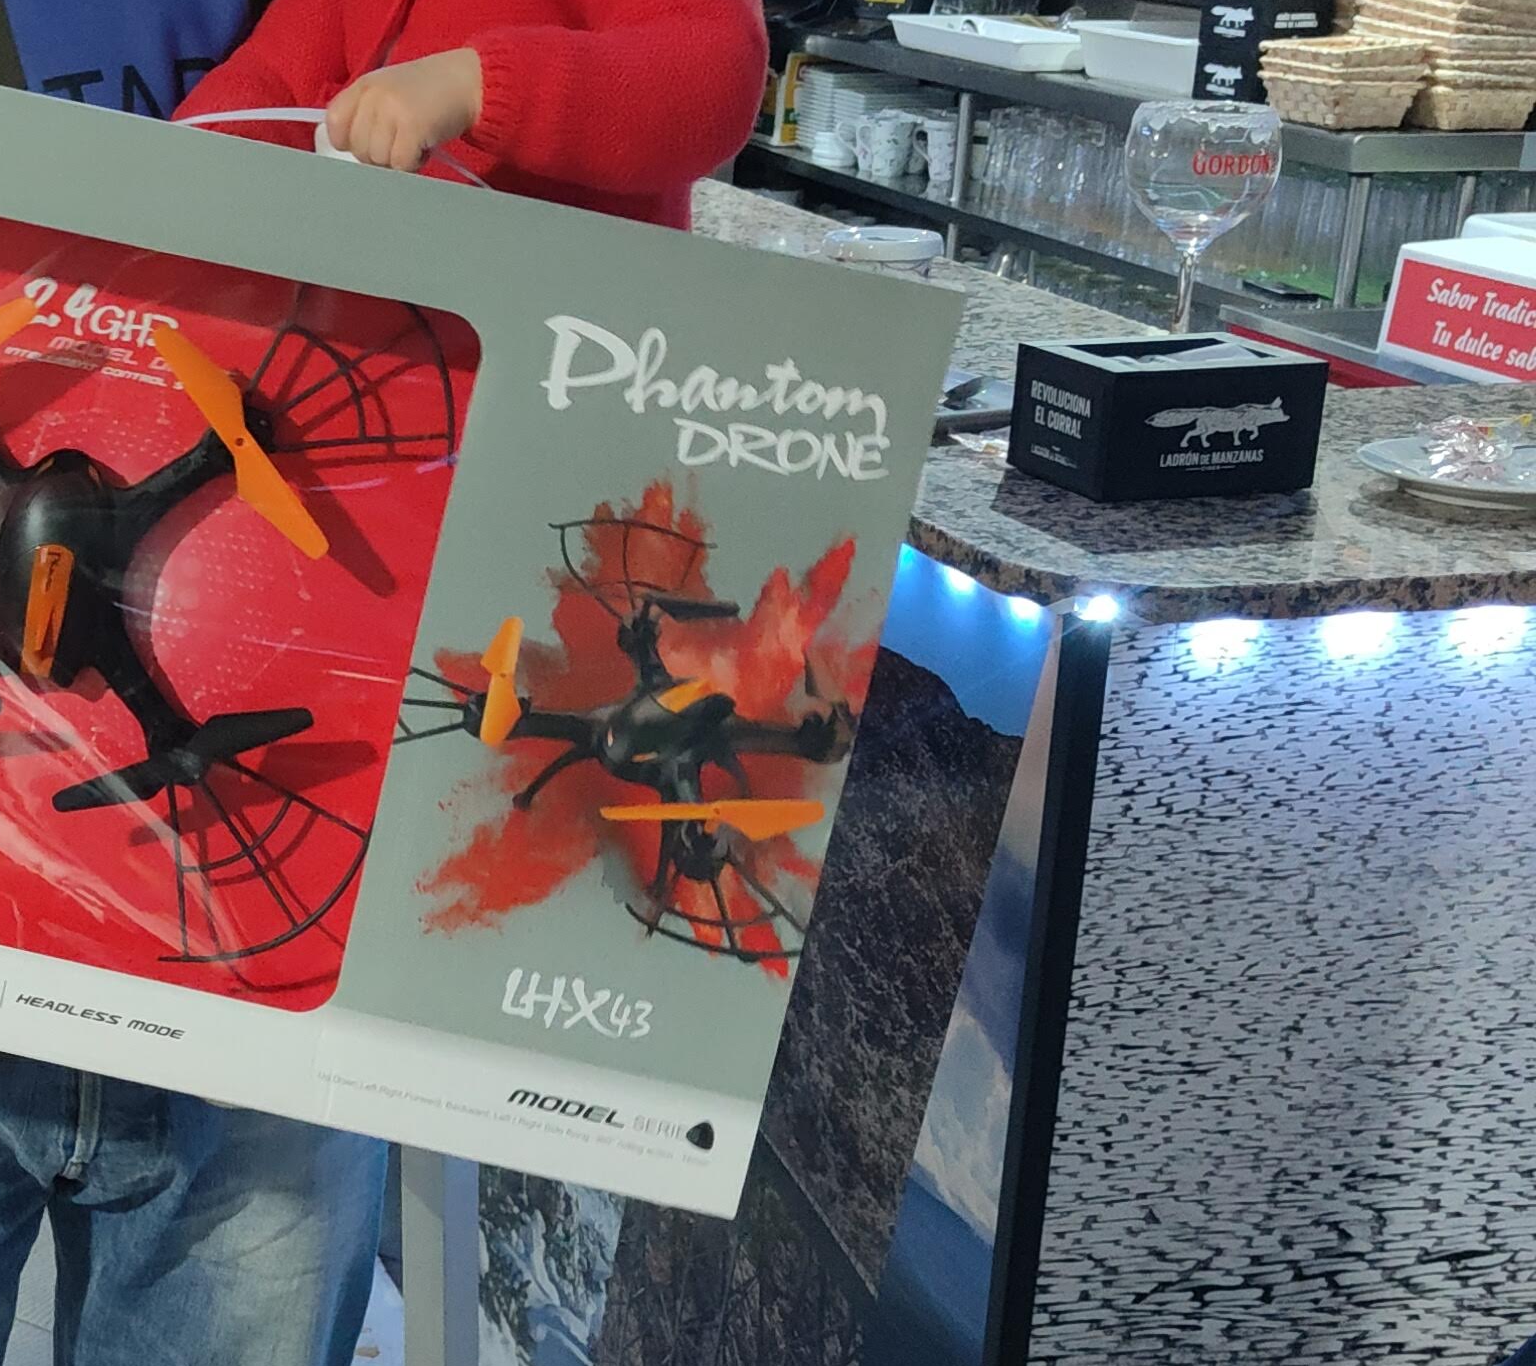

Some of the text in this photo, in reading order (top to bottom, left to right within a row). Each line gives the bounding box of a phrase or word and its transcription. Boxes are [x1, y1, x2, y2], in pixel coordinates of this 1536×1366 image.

[1426, 278, 1479, 312] Sabor
[1432, 320, 1453, 347] Tu
[1454, 327, 1504, 361] dulce
[100, 366, 168, 388] CONTROL
[539, 315, 889, 438] Phantom
[1030, 379, 1091, 419] REVOLUCIONA
[1034, 404, 1082, 440] EL CORRAL
[672, 417, 891, 481] DRONE
[1159, 450, 1200, 468] LADRÓN
[1211, 448, 1264, 464] MANZANAS
[15, 993, 123, 1026] HEADLESS
[127, 1018, 187, 1041] MODE
[507, 1088, 625, 1129] MODEL
